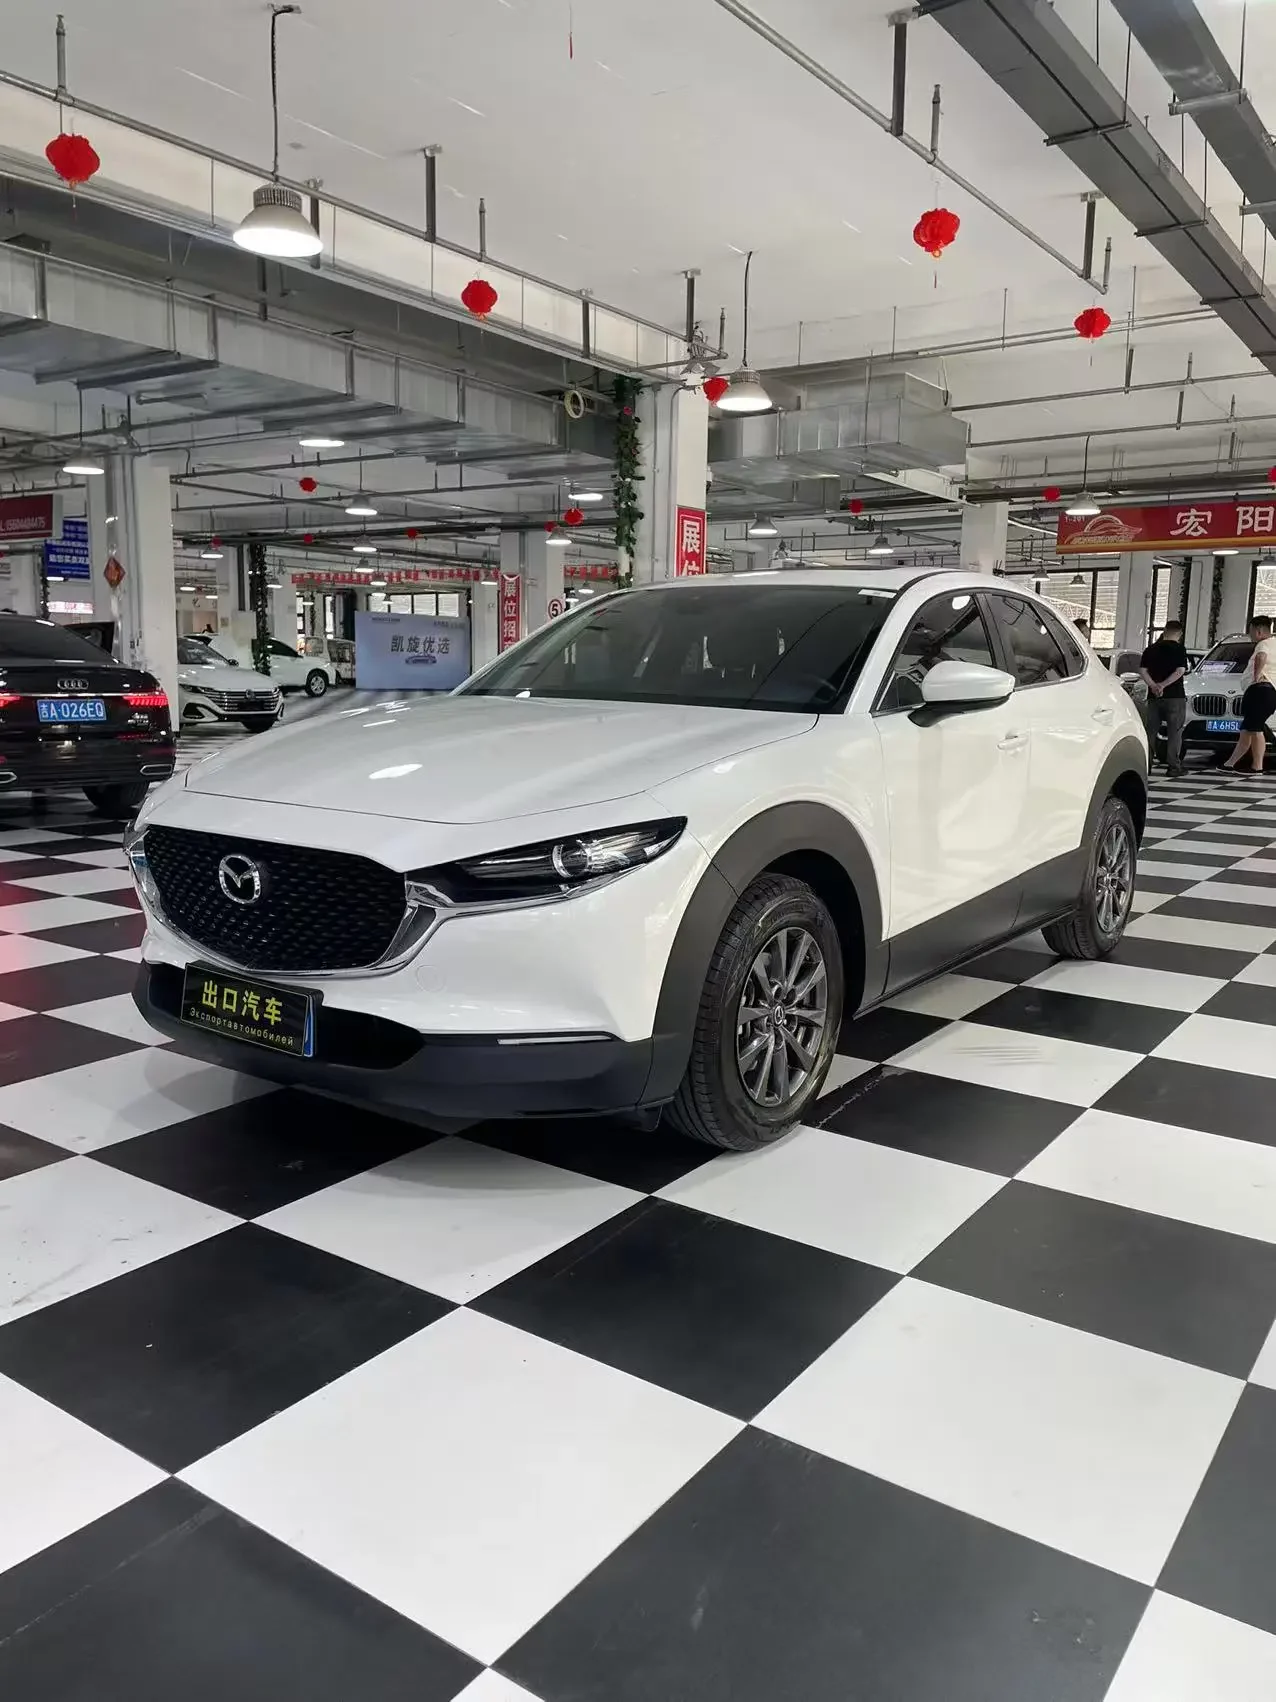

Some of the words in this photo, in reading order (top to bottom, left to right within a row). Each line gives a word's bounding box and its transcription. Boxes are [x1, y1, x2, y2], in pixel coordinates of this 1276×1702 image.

[1169, 506, 1275, 536] 宏阳
[390, 634, 451, 654] 凯旋优选
[201, 979, 283, 1026] 出口汽车
